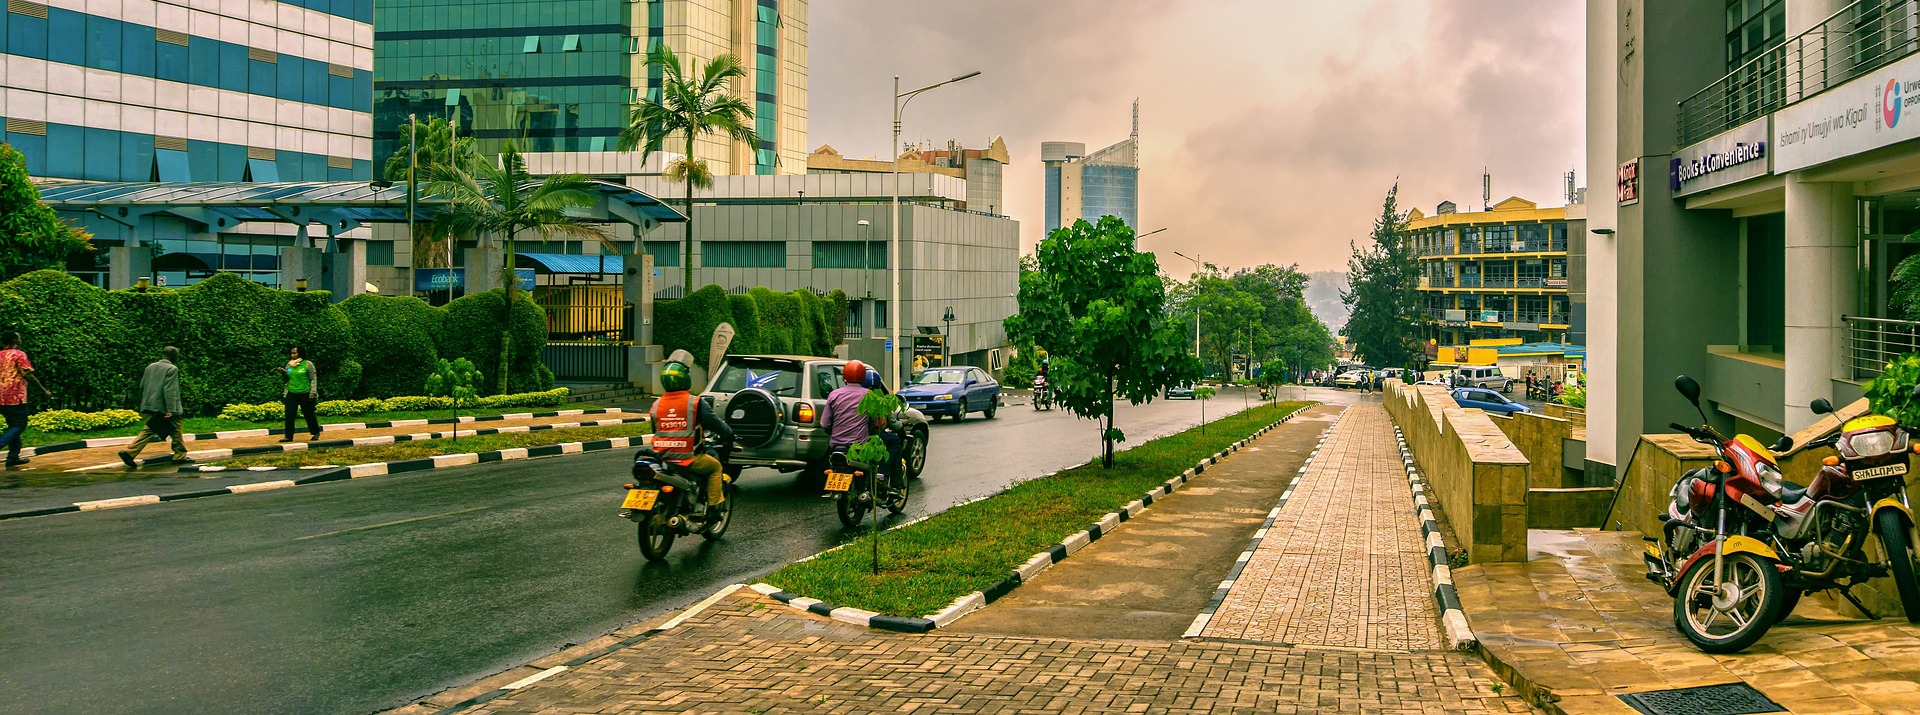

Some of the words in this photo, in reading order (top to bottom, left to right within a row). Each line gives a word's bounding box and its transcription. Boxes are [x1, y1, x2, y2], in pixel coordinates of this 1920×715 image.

[1780, 126, 1800, 148] Ishami
[1833, 115, 1844, 130] wa
[1845, 103, 1868, 129] Kigali
[1678, 161, 1699, 182] Books
[1700, 155, 1706, 174] &
[1706, 141, 1760, 173] Convenience
[431, 272, 459, 284] Ecobank
